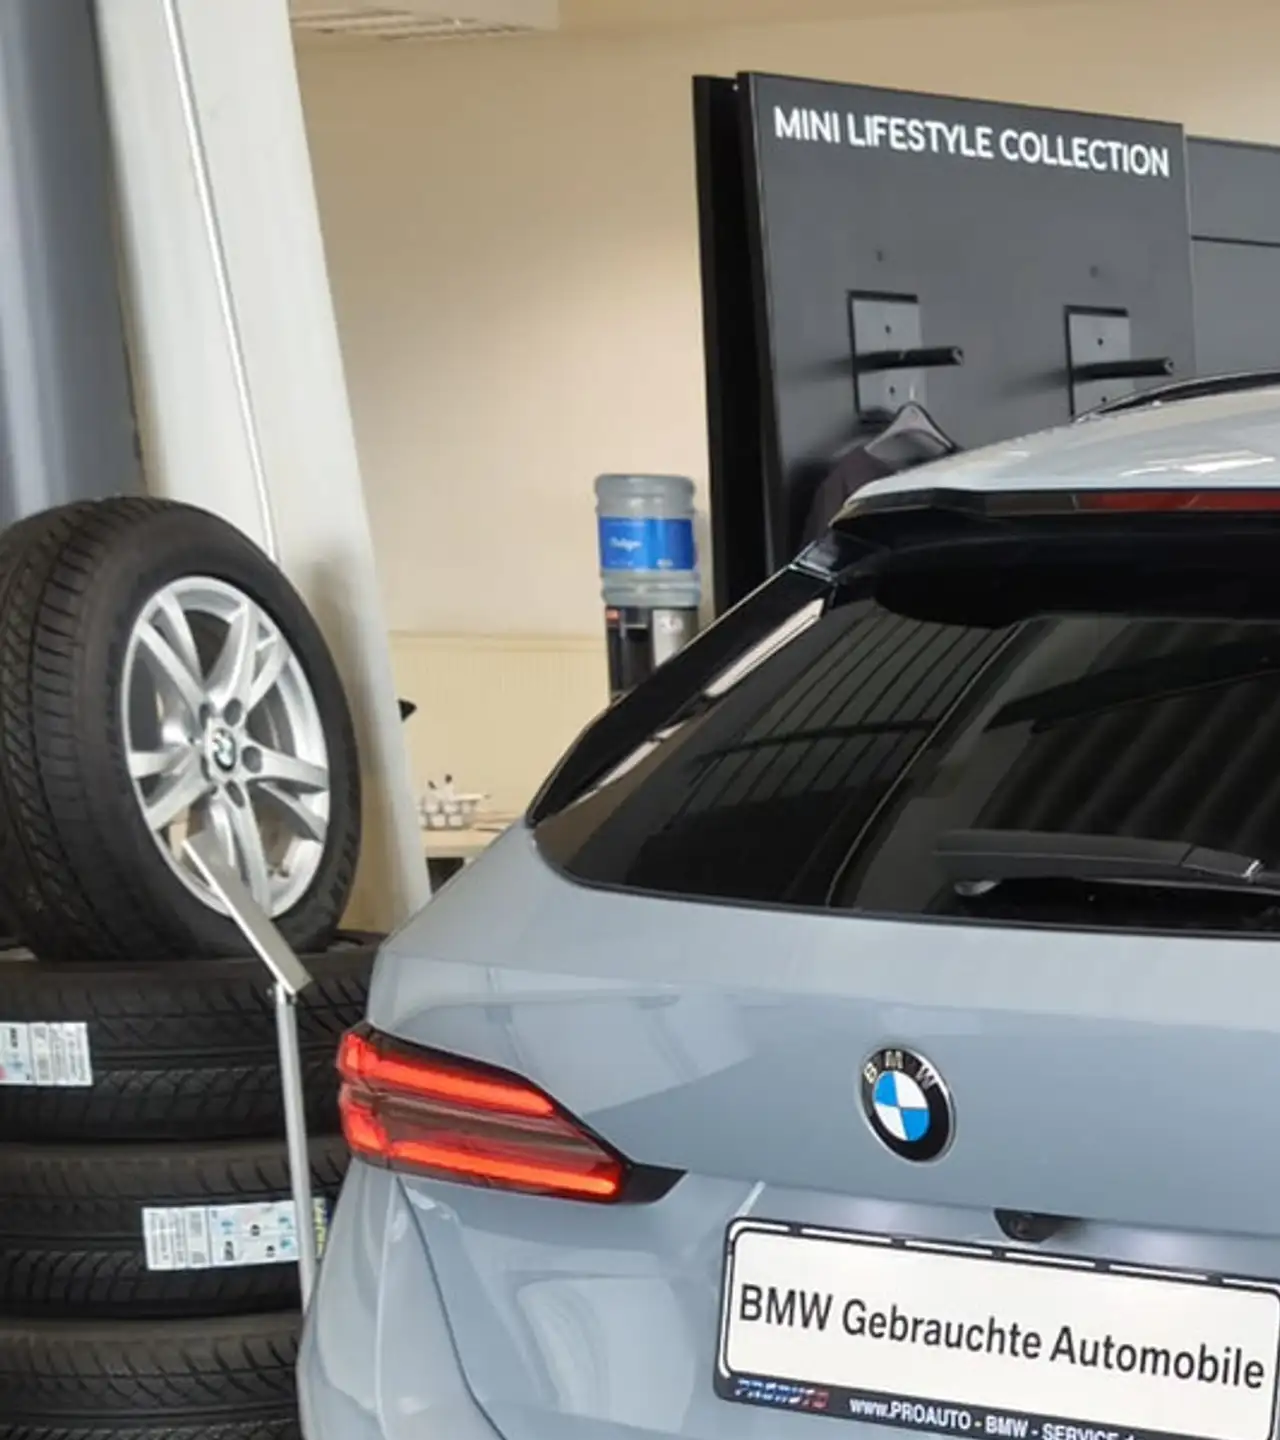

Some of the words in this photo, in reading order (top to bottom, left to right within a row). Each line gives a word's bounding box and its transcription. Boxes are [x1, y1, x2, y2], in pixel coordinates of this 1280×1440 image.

[773, 105, 842, 145] MINI
[846, 112, 995, 159] LIFESTYLE
[999, 128, 1171, 178] COLLECTION
[863, 1050, 938, 1092] BMW
[739, 1283, 832, 1332] BMW
[842, 1298, 1042, 1360] Gebrauchte
[1050, 1325, 1265, 1390] Automobile
[848, 1397, 973, 1431] www.PROAUTO
[984, 1414, 1029, 1439] BMW
